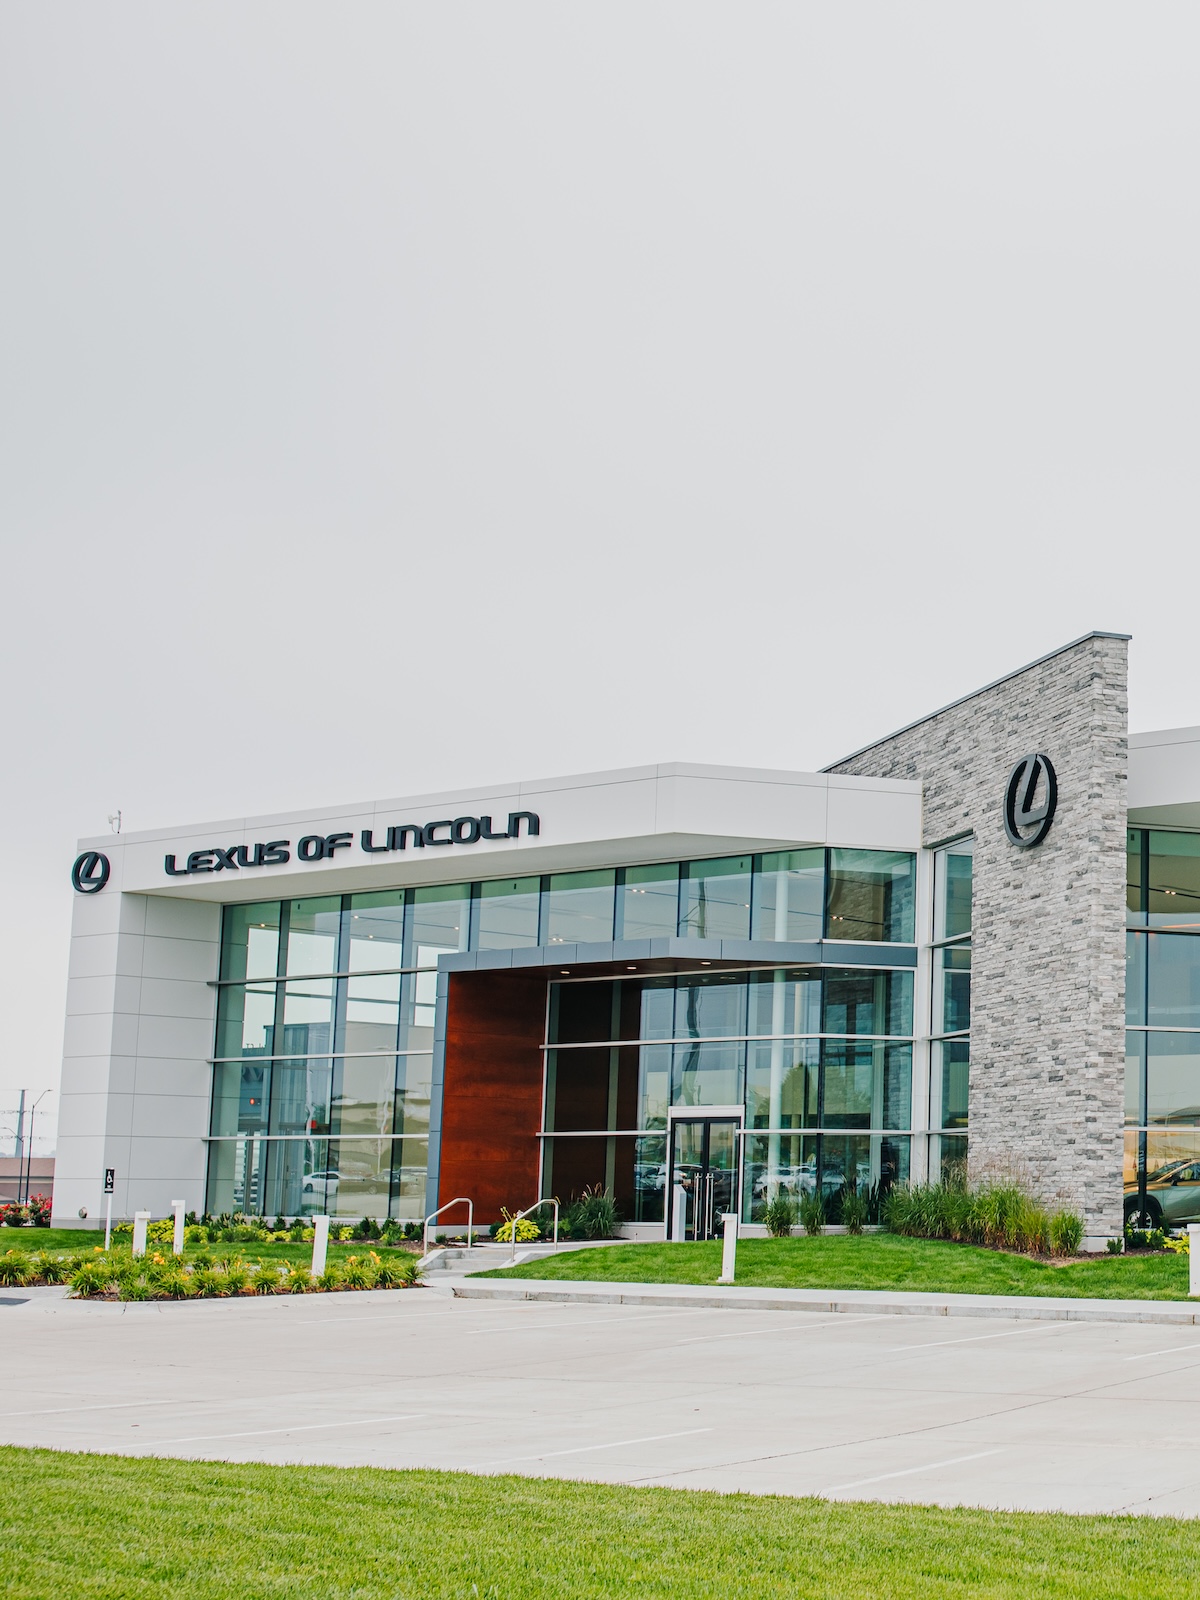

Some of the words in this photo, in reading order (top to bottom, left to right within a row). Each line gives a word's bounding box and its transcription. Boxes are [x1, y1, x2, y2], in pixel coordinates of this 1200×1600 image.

[164, 839, 291, 876] LEXUS
[297, 832, 354, 862] OF
[360, 811, 541, 854] LINCOLN
